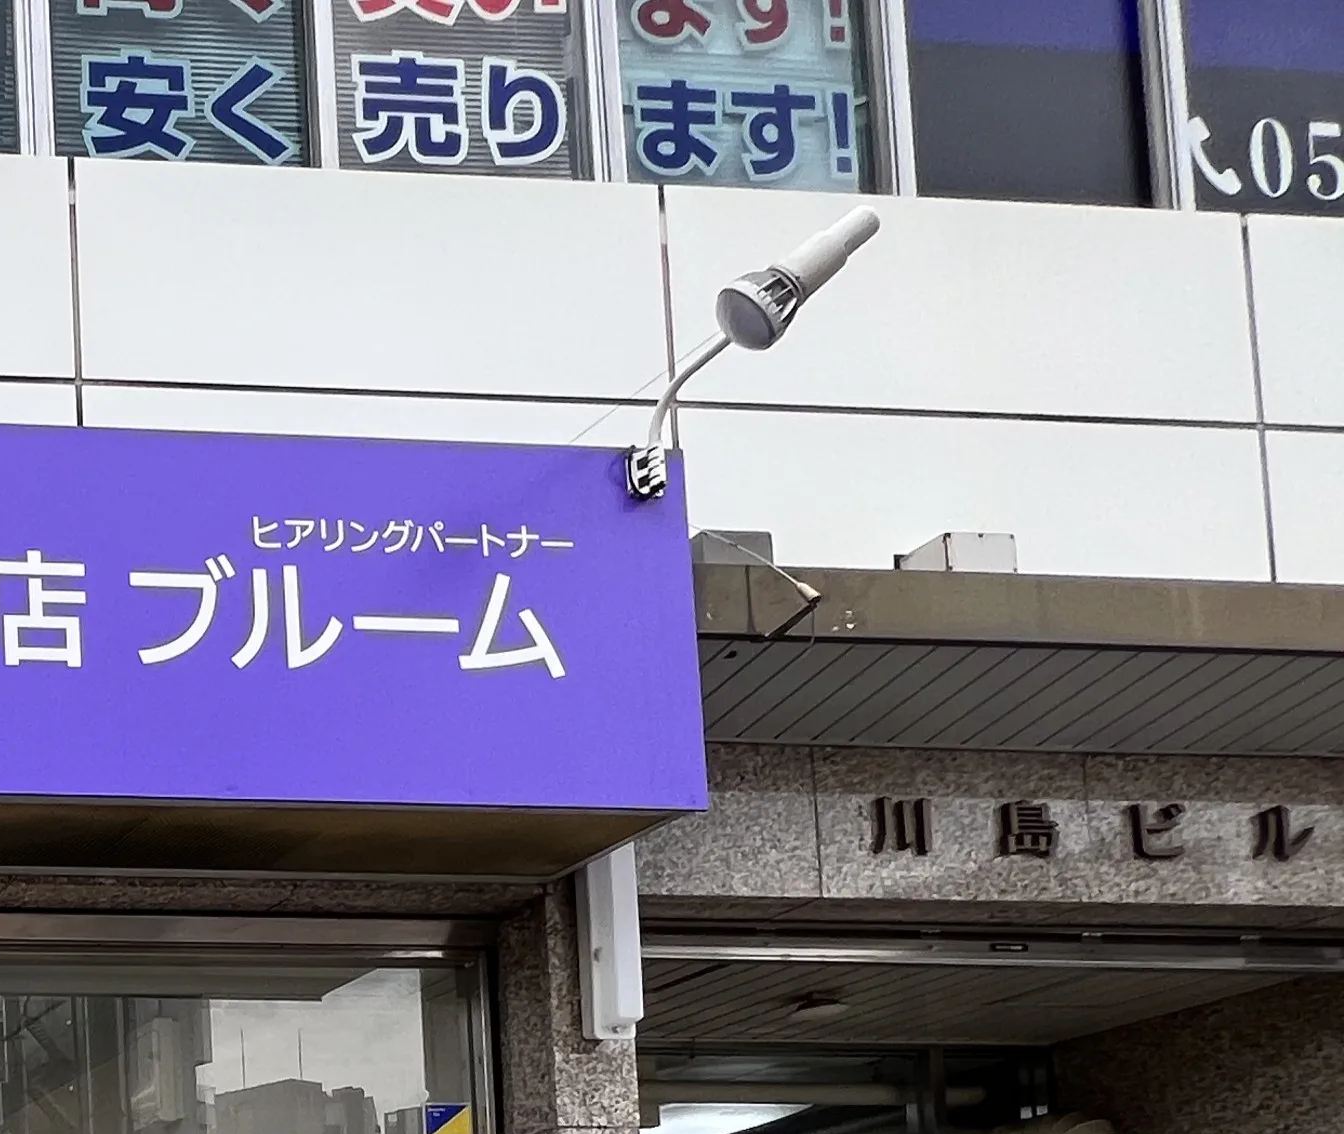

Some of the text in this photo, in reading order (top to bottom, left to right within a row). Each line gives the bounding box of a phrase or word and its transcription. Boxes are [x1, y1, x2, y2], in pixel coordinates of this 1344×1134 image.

[251, 515, 575, 558] ヒアリングパートナー
[128, 553, 567, 679] ブルーム
[872, 796, 1316, 862] 川島ビル
